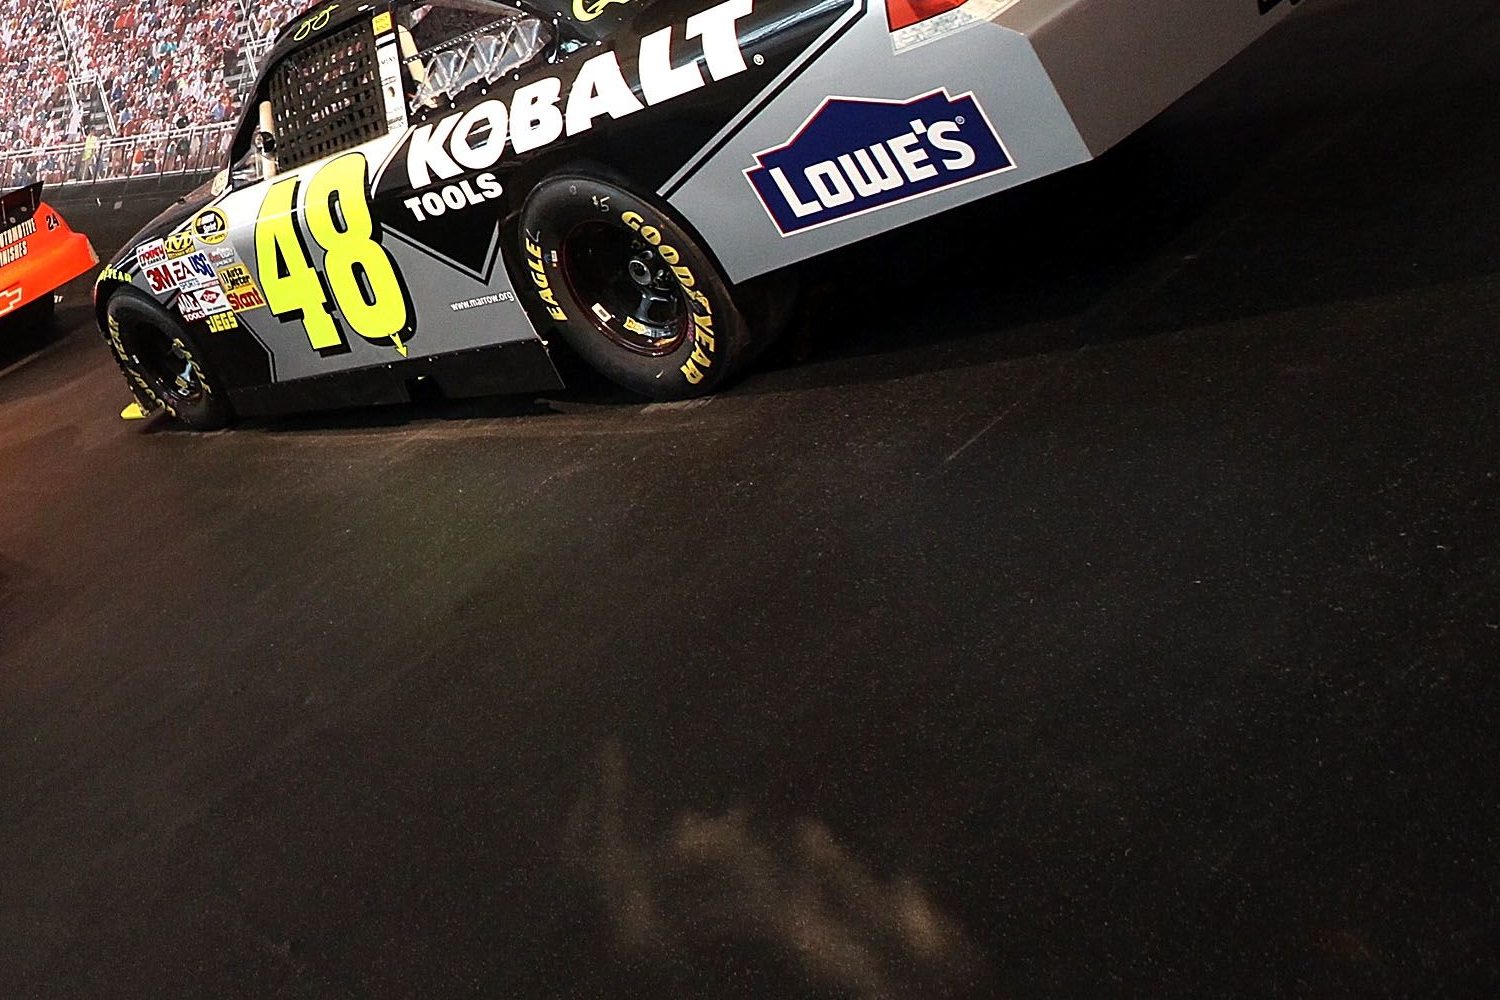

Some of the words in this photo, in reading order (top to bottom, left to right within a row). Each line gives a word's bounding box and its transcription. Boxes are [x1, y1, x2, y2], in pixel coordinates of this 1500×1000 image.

[768, 118, 976, 218] LOWE'S
[404, 173, 504, 224] TOOLS
[45, 215, 60, 232] 24
[255, 151, 407, 352] 48
[147, 263, 177, 292] 3M
[178, 277, 201, 290] SPORTS
[525, 238, 569, 321] EAGLE
[450, 291, 515, 311] www.marrow.org
[621, 211, 715, 385] GOODYEAR
[183, 310, 206, 323] TOOLS
[206, 311, 239, 333] JEGS
